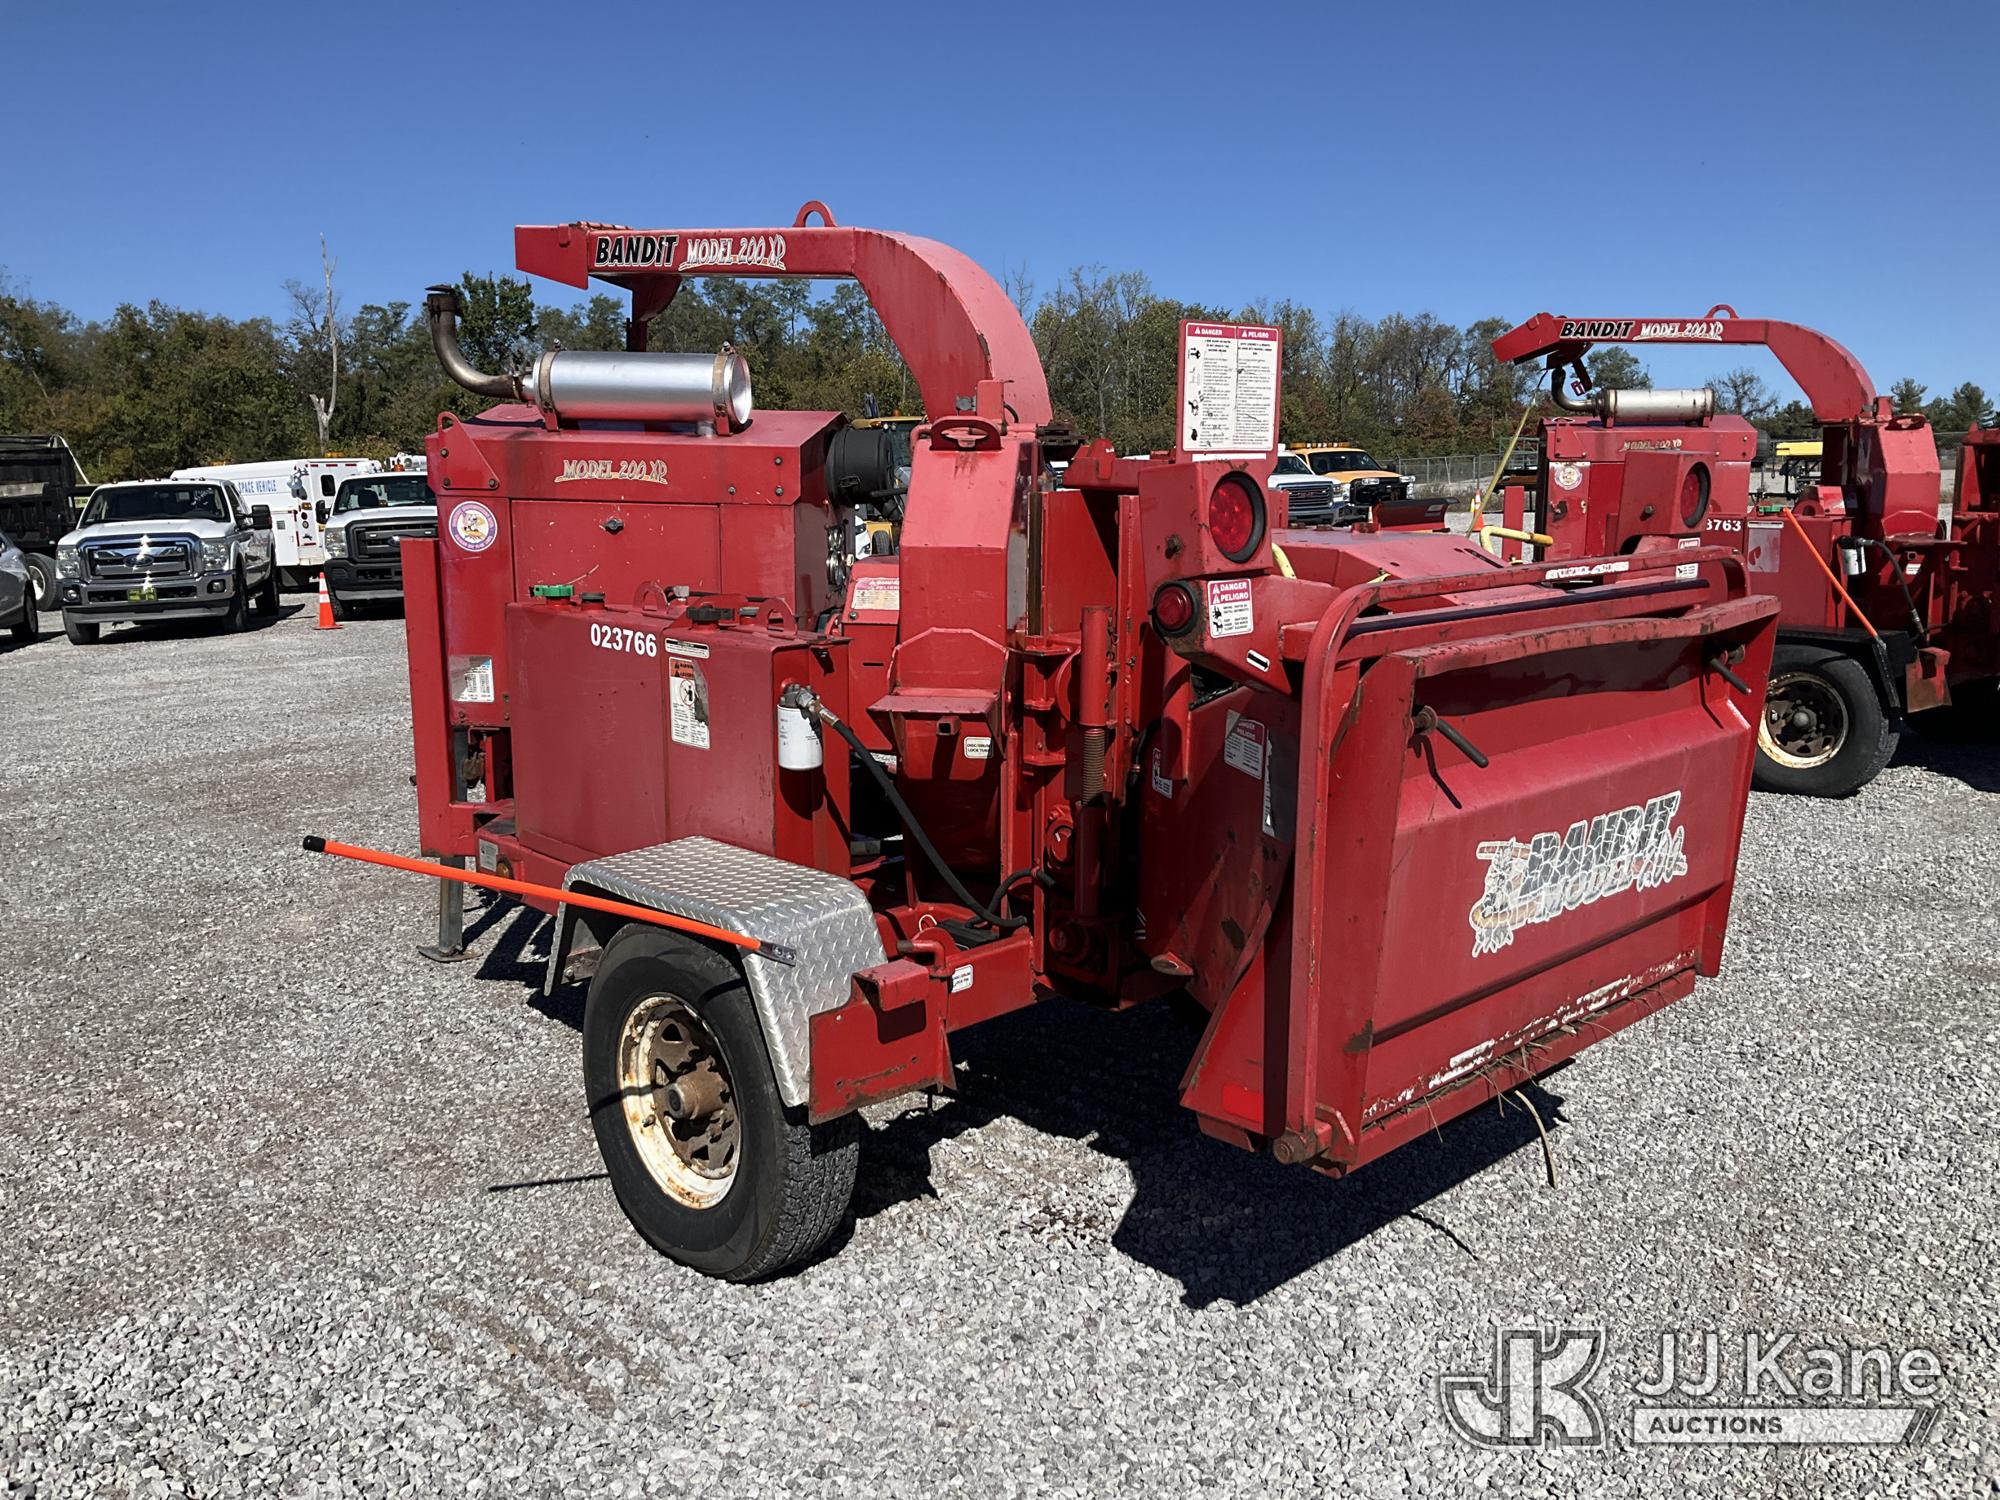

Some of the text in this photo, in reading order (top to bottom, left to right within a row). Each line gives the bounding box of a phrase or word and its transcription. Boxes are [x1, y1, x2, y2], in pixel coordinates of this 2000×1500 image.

[595, 235, 679, 267] BANDIT
[686, 238, 733, 265] MODEL
[738, 236, 766, 264] 200
[1201, 328, 1223, 336] DANGER
[1248, 331, 1269, 339] PELIGRO
[1560, 321, 1635, 339] BANDIT
[1641, 323, 1681, 337] MODEL
[1684, 322, 1707, 338] 200
[563, 460, 612, 479] MODEL
[618, 460, 647, 480] 200
[1220, 582, 1247, 591] DANGER
[1220, 592, 1248, 602] PELIGRO
[590, 623, 657, 657] 023766
